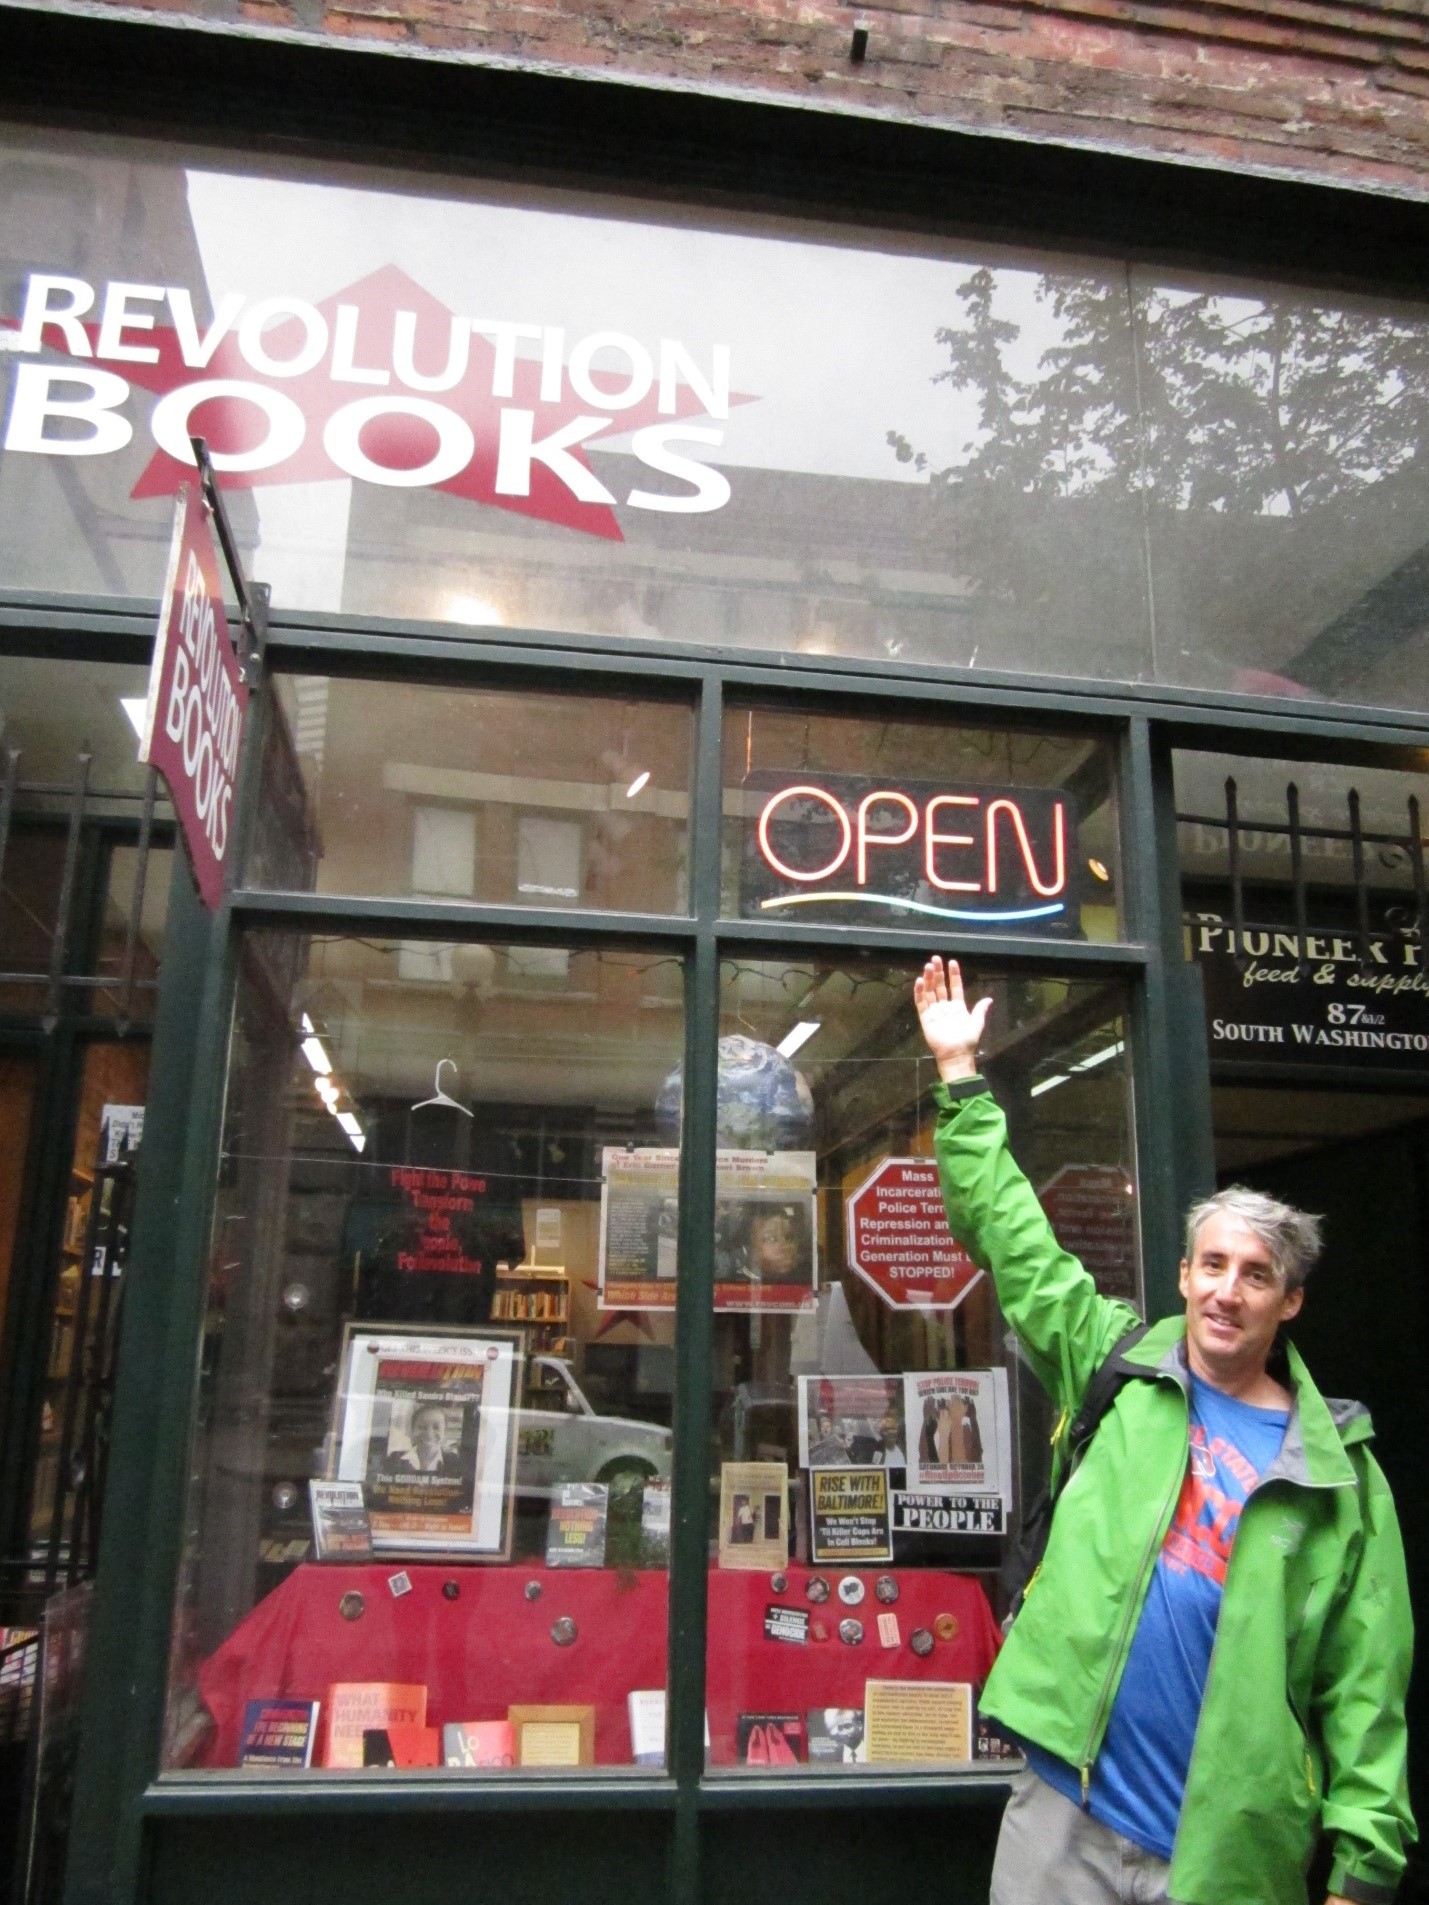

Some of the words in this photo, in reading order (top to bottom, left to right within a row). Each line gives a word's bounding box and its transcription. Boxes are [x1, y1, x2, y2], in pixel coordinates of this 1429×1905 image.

[22, 273, 730, 420] REVOLUTION
[4, 362, 731, 513] BOOKS
[166, 644, 232, 862] BOOKS
[758, 785, 1065, 896] OPEN
[1242, 960, 1300, 988] feed
[1312, 963, 1337, 986] &
[1212, 1019, 1285, 1044] SOUTH
[1291, 1024, 1429, 1051] WASHINGTO
[901, 1169, 934, 1182] Mass
[878, 1201, 917, 1214] Police
[860, 1217, 931, 1231] Repression
[861, 1233, 954, 1246] Criminalization
[860, 1250, 929, 1263] Generation
[932, 1250, 962, 1263] Must
[889, 1266, 955, 1279] STOPPED!
[819, 1475, 846, 1492] RISE
[850, 1475, 881, 1492] WITH
[817, 1493, 885, 1511] BALTIMORE!
[897, 1494, 944, 1509] POWER
[949, 1496, 968, 1510] TO
[973, 1497, 999, 1510] THE
[825, 1517, 838, 1526] We
[838, 1517, 859, 1526] Won't
[860, 1516, 876, 1527] Stop
[902, 1508, 995, 1532] PEOPLE
[852, 1527, 871, 1538] Cops
